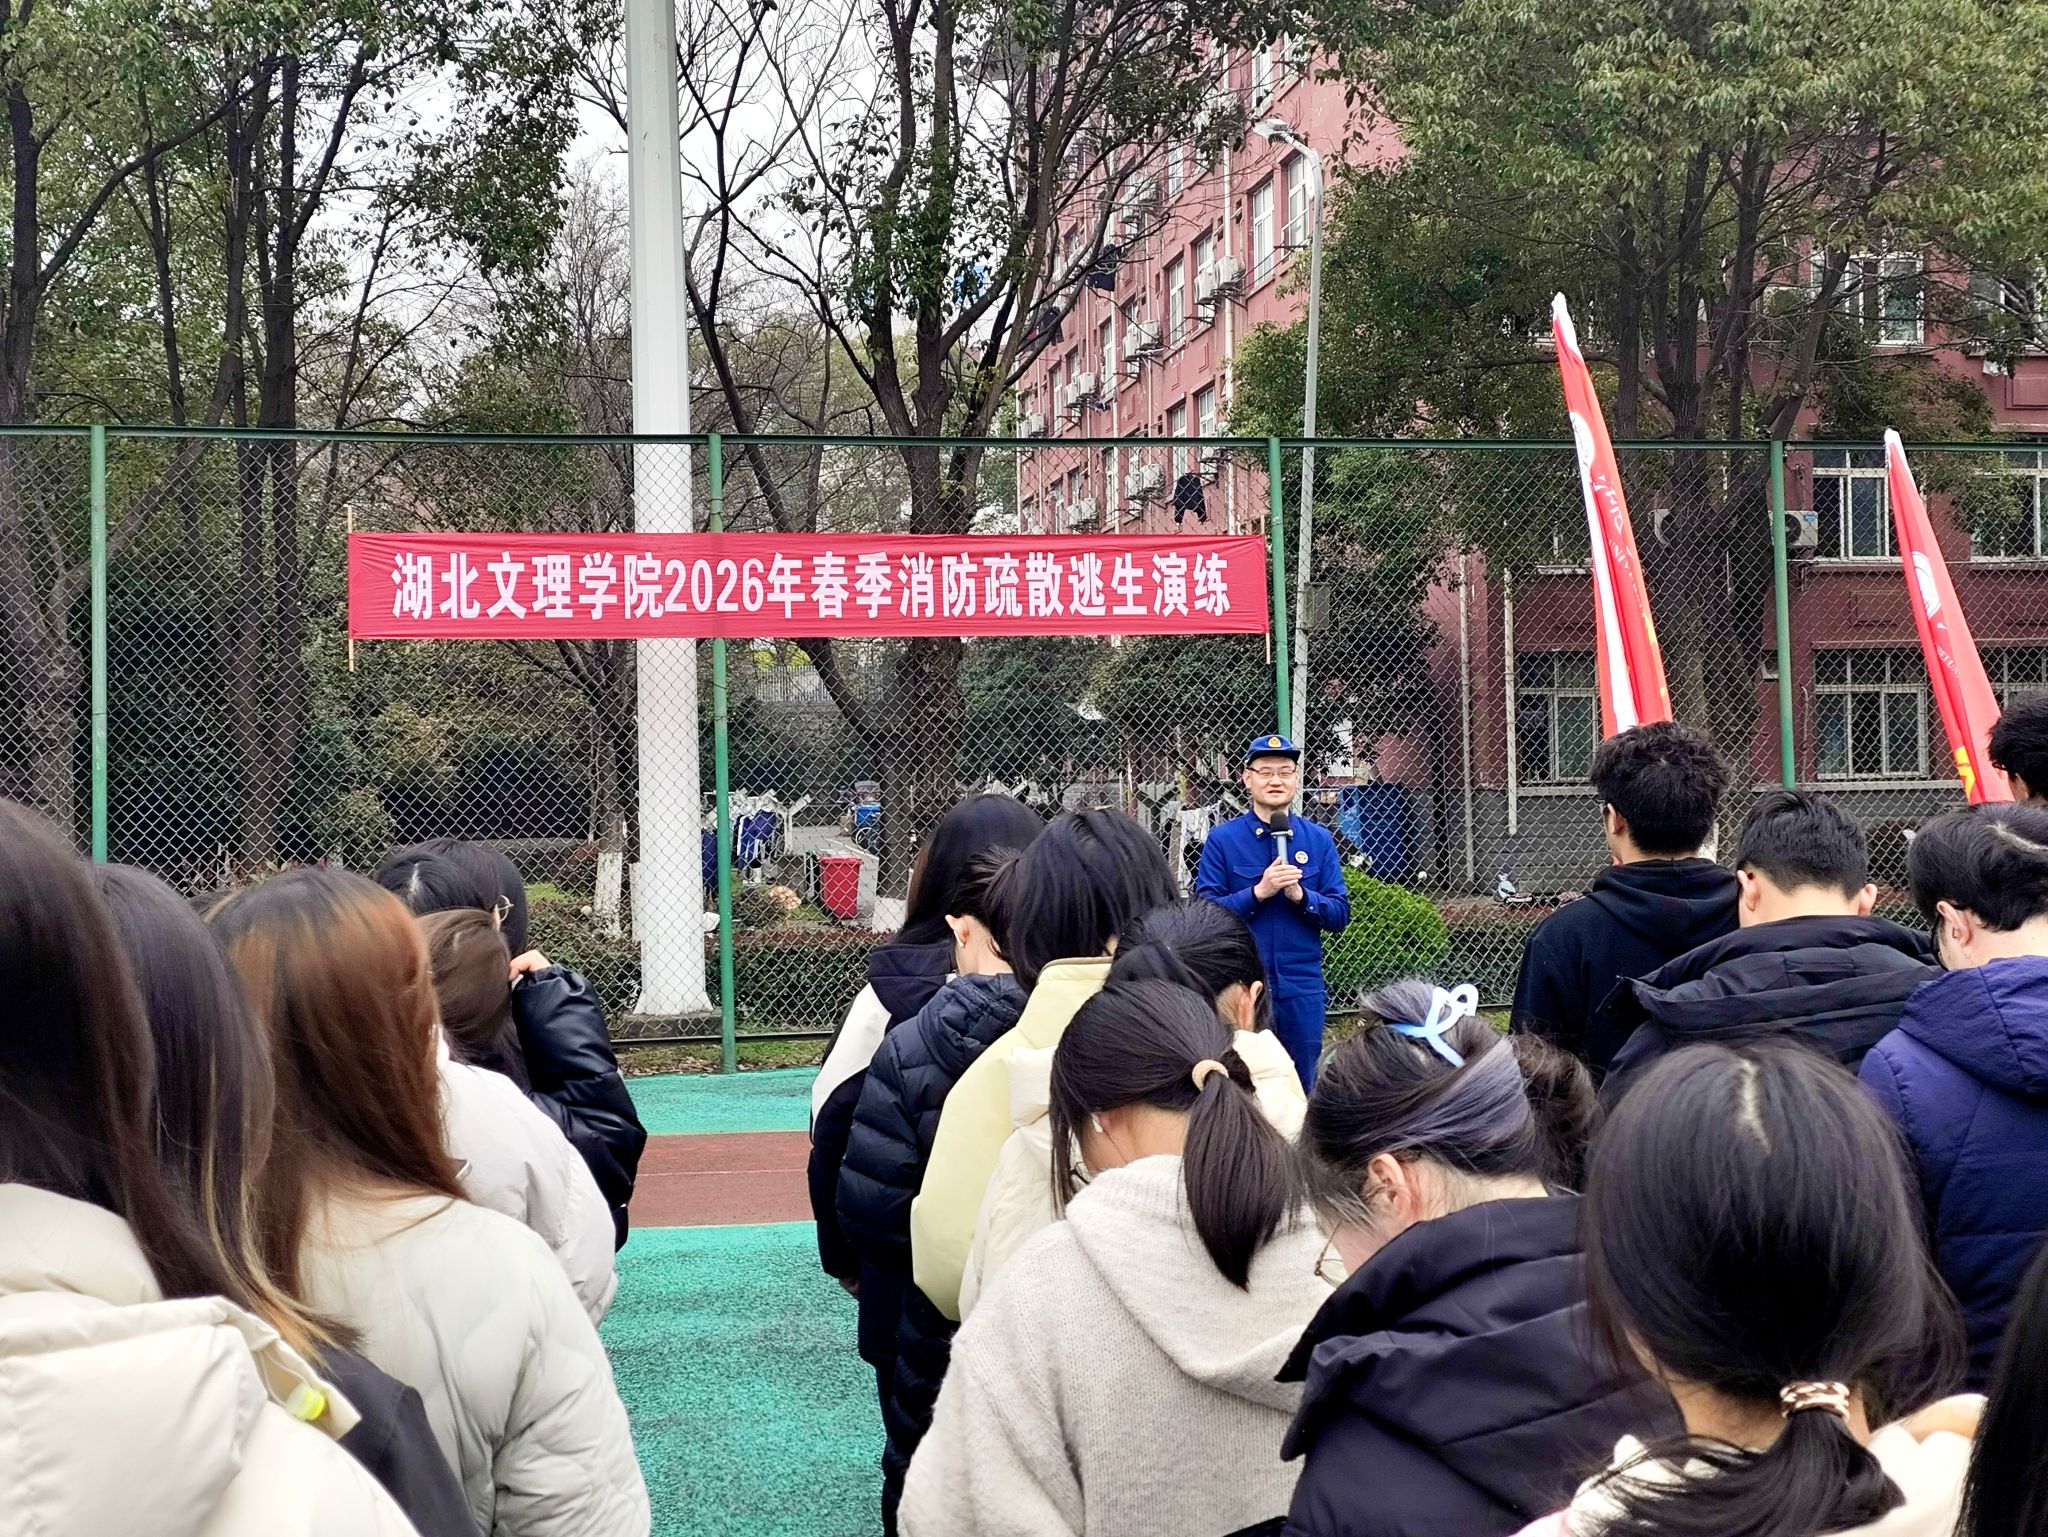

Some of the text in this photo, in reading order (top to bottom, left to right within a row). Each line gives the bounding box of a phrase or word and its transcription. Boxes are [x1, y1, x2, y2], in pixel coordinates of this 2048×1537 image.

[391, 550, 1231, 620] 湖北文理学院2026年春季消防疏散逃生演练
